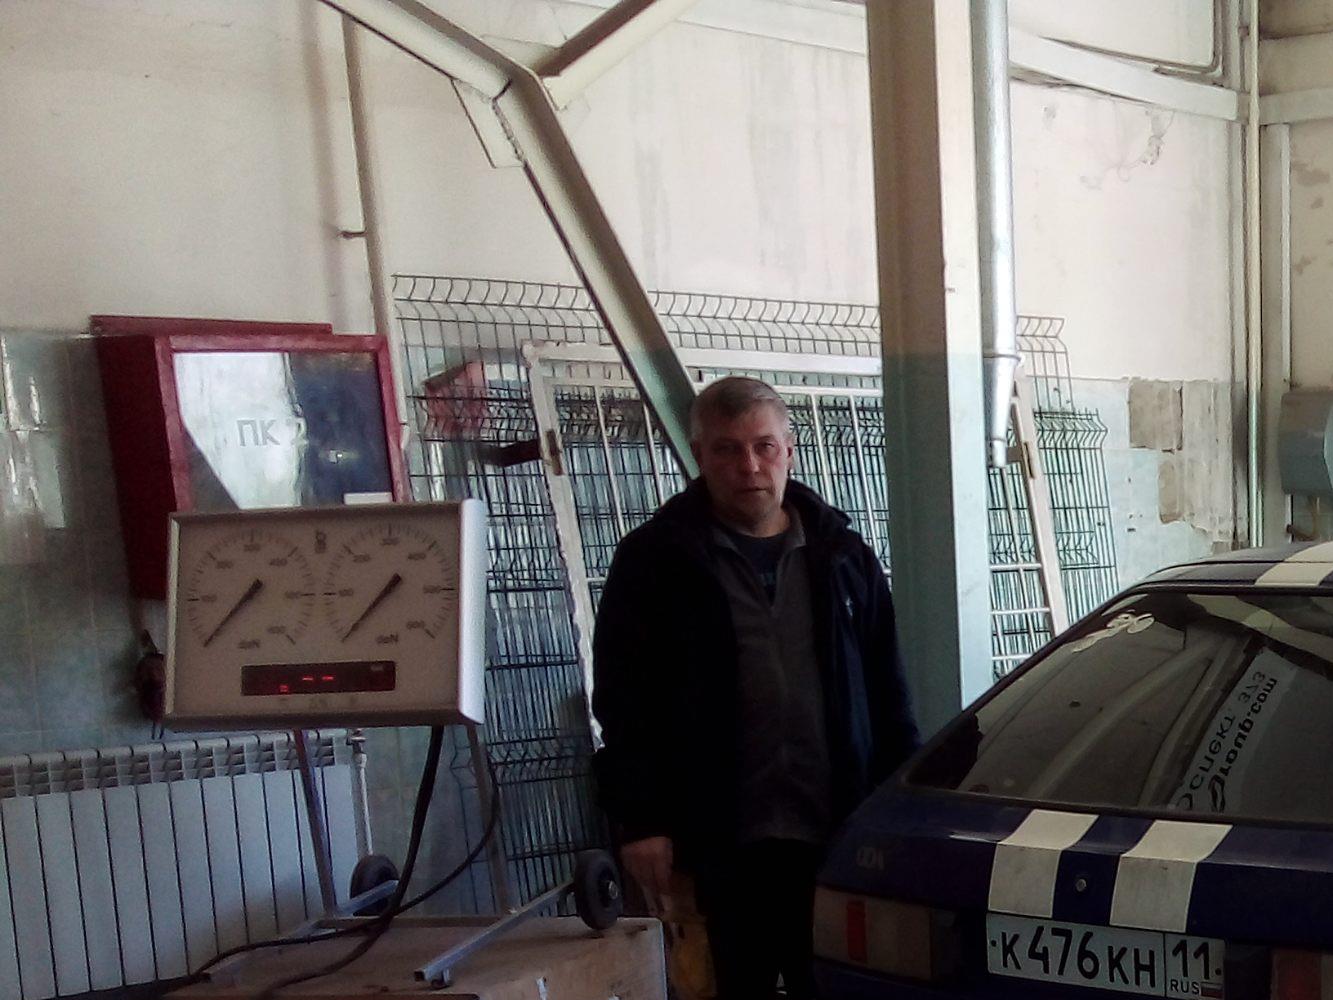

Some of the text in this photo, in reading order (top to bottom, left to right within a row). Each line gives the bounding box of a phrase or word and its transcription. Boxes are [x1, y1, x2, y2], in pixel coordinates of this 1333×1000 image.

[236, 419, 281, 447] ПК
[1172, 939, 1211, 980] 11
[1169, 979, 1200, 995] RUS
